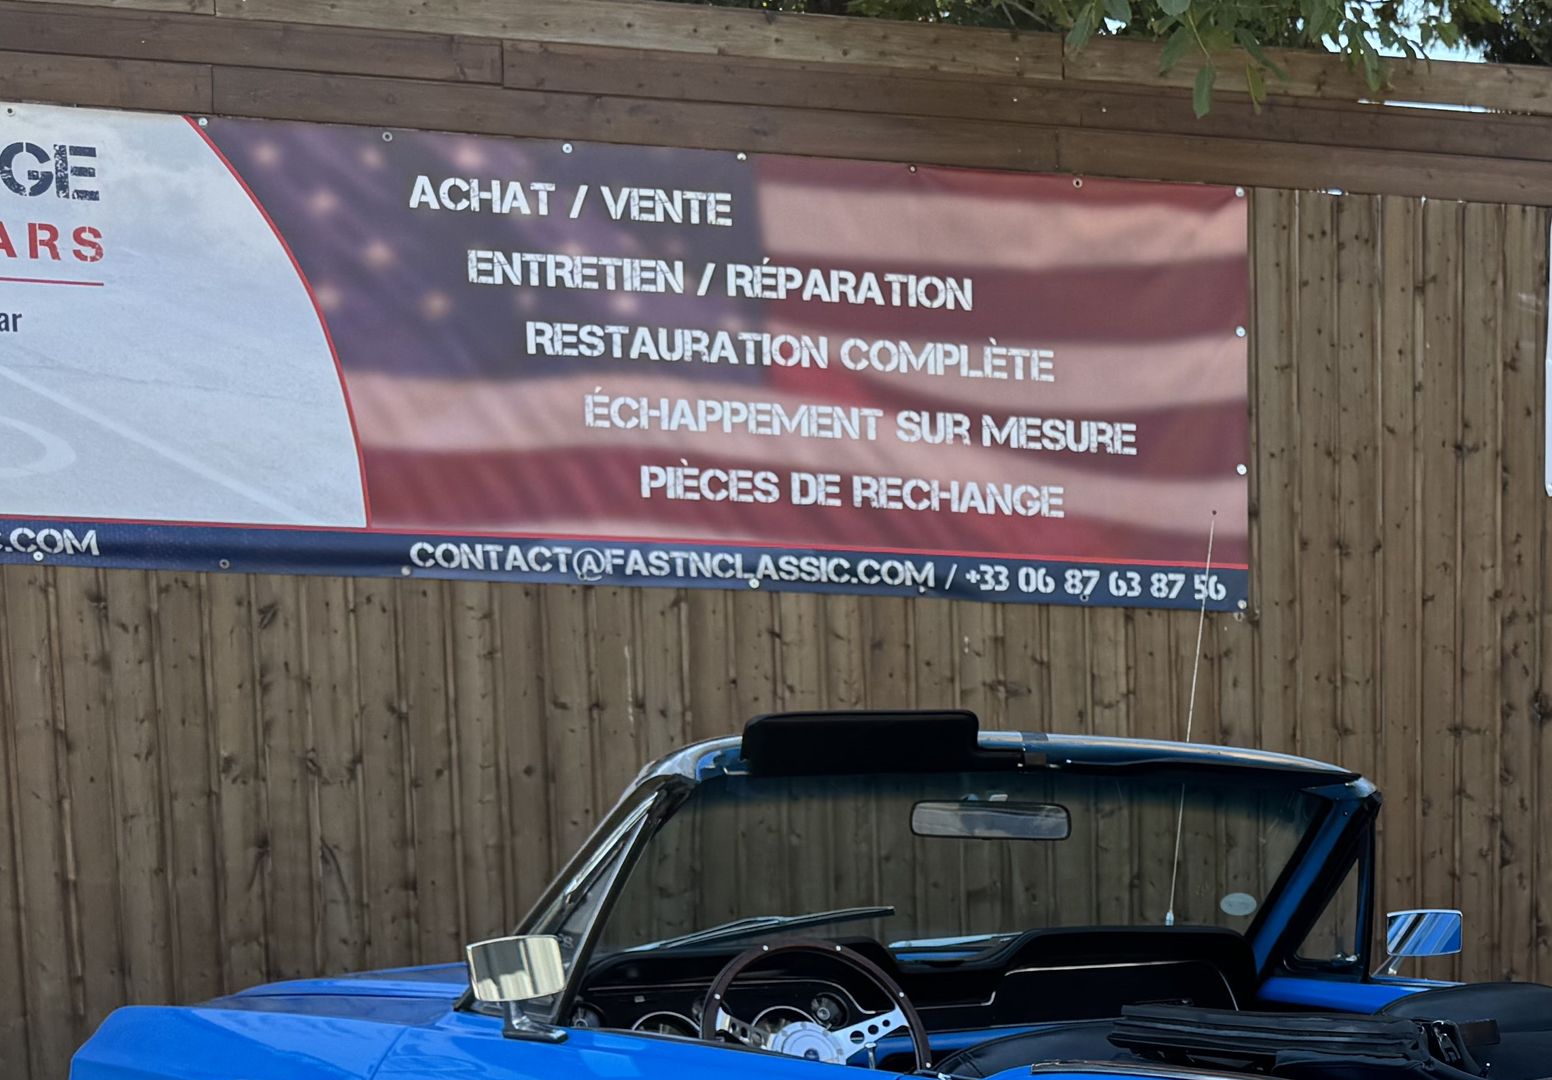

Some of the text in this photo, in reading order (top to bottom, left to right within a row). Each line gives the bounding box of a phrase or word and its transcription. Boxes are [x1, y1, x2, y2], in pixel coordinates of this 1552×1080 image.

[0, 141, 100, 201] GE
[409, 175, 733, 227] ACHAT / VENTE
[467, 249, 973, 312] ENTRETIEN / RÉPARATION
[526, 320, 1055, 382] RESTAURATION COMPLÈTE
[584, 385, 1138, 456] ÉCHAPPEMENT SUR MESURE
[639, 457, 1065, 519] PIÈCES DE RECHANGE
[0, 527, 100, 556] .COM
[409, 541, 1228, 602] CONTACT@FASTNCLASSIC.COM / +33 06 87 63 87 56
